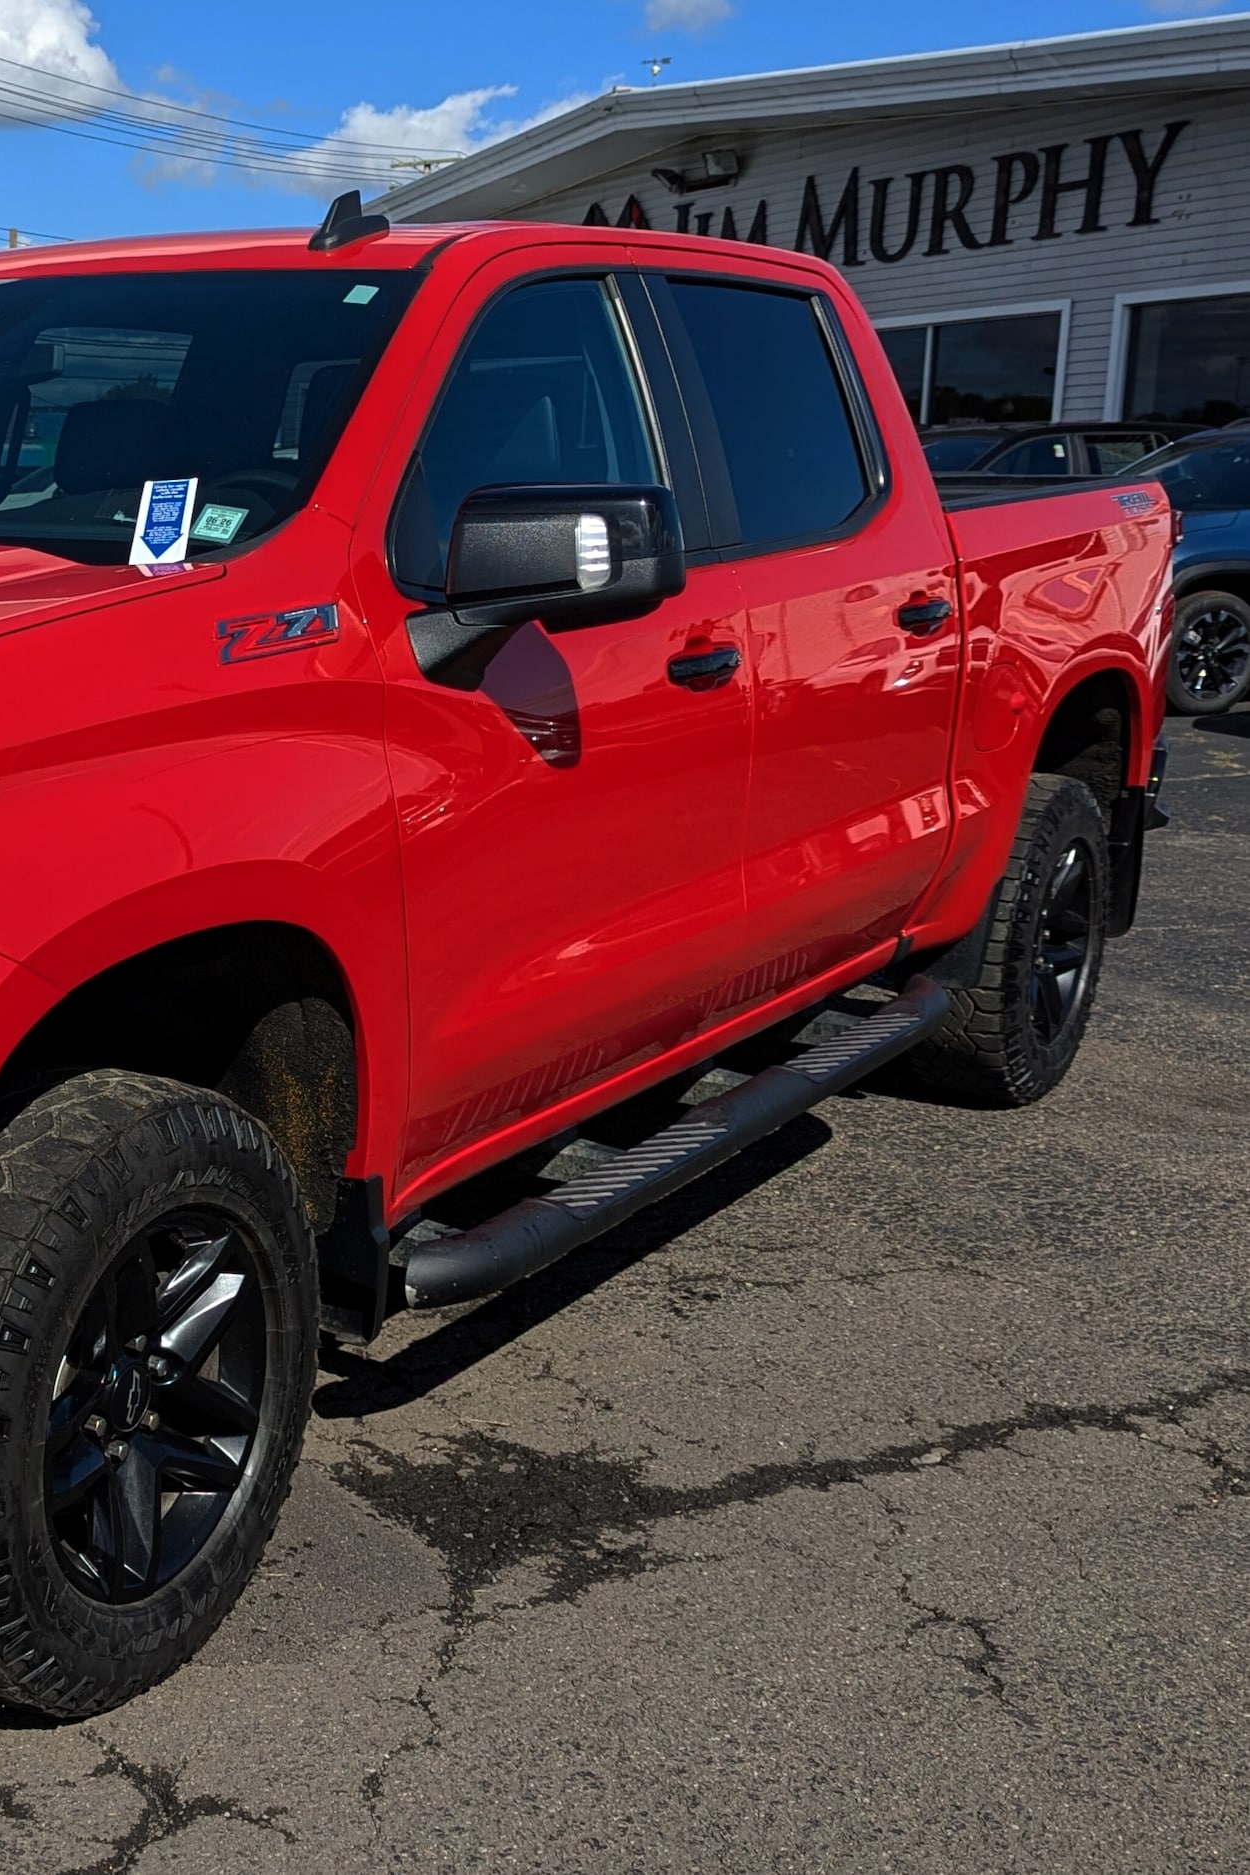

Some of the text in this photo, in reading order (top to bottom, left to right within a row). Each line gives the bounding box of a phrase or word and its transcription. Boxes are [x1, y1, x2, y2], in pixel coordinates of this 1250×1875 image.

[795, 120, 1190, 266] MURPHY
[1110, 491, 1155, 507] TRAIL
[206, 516, 233, 526] 06 26
[216, 602, 339, 666] Z71
